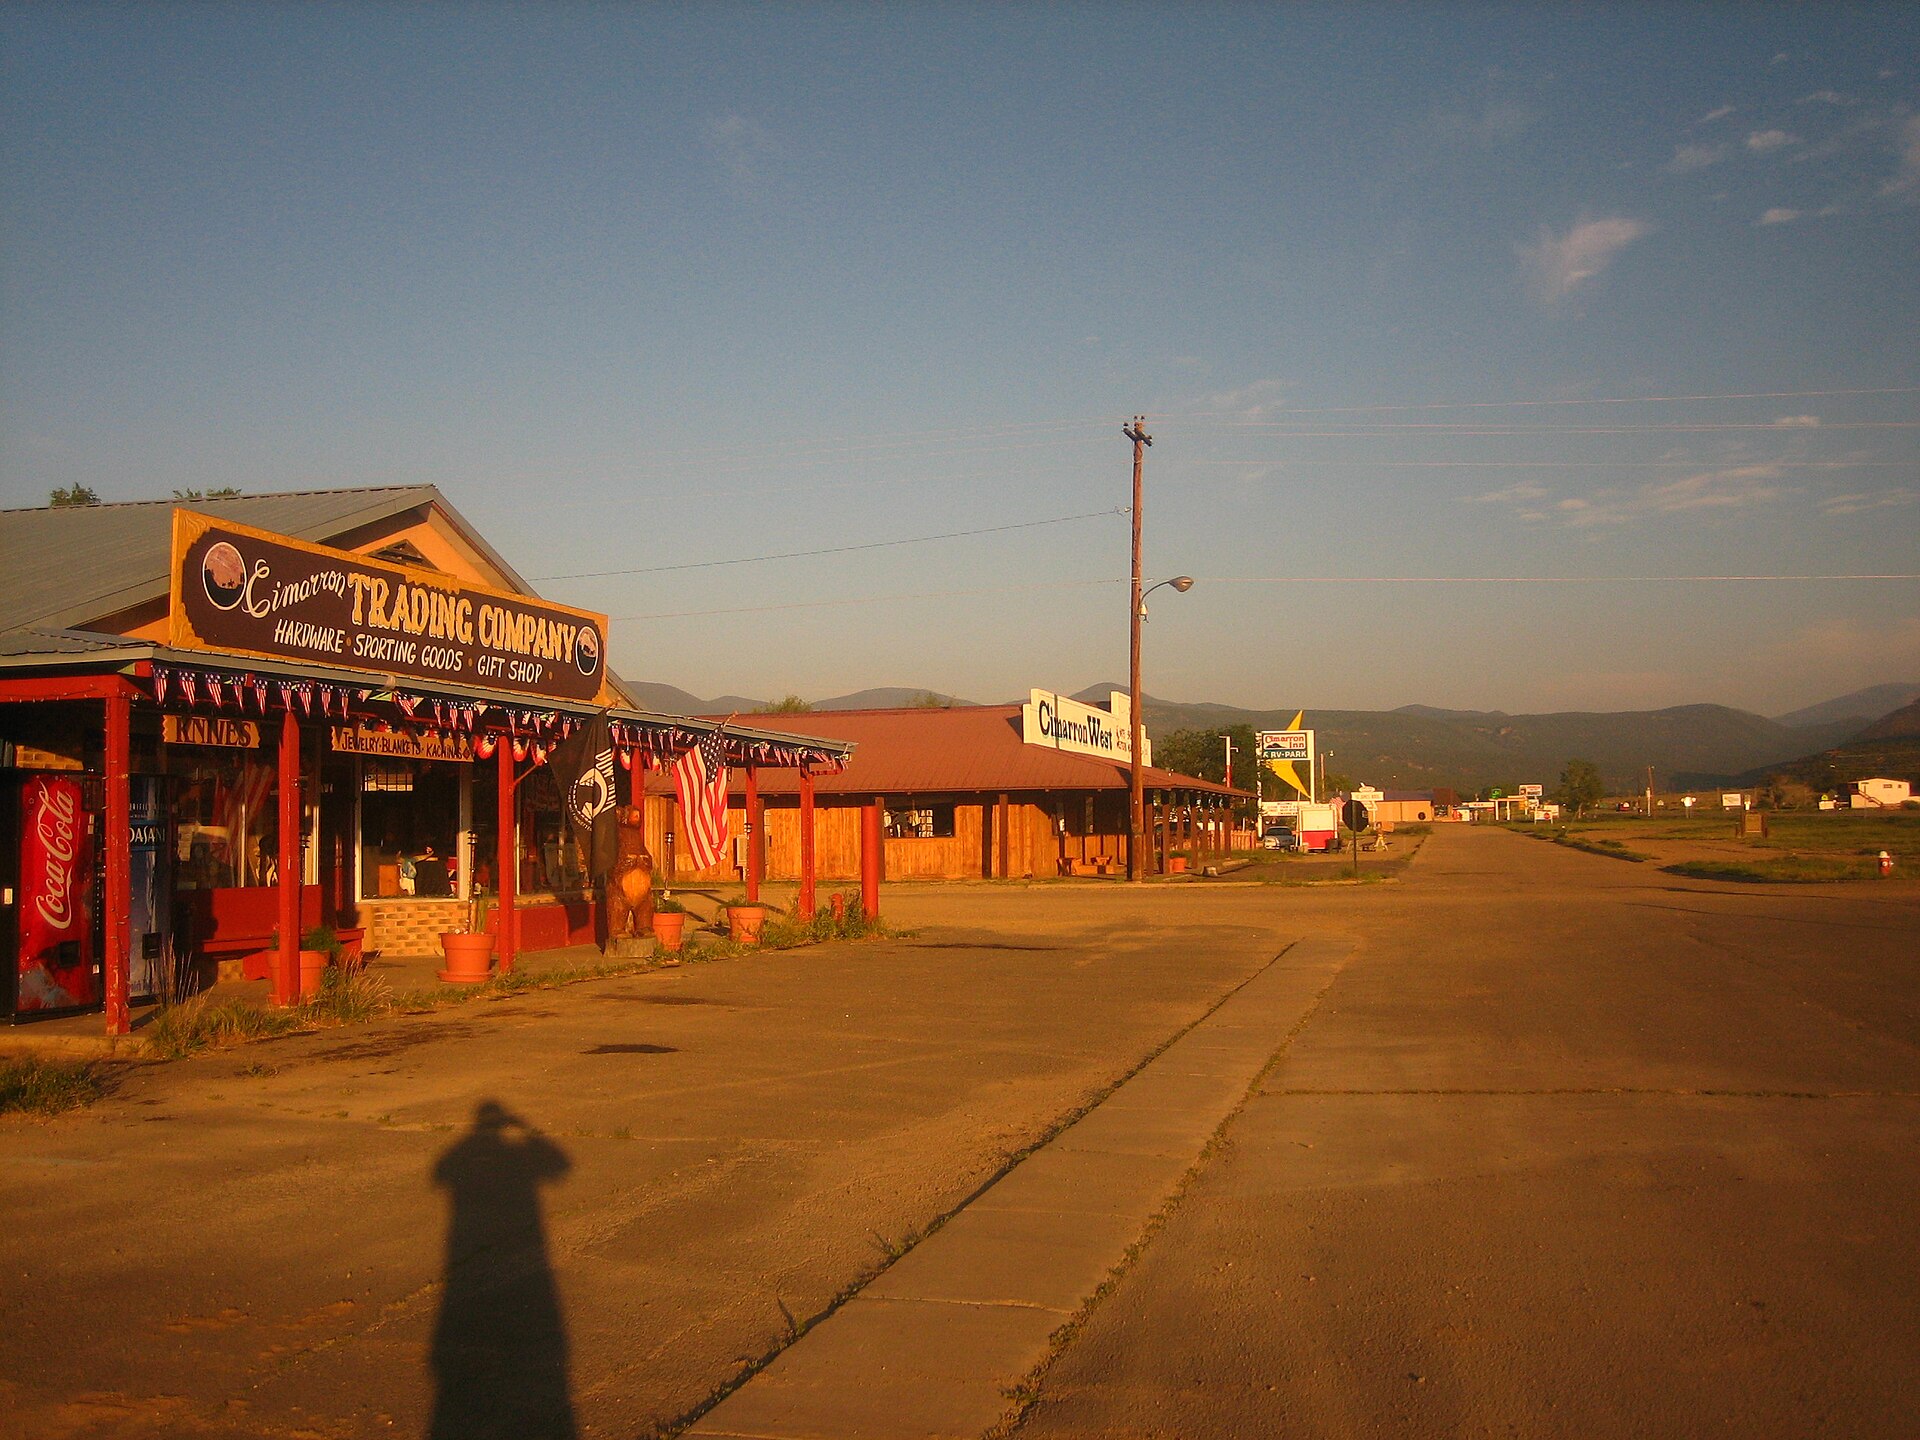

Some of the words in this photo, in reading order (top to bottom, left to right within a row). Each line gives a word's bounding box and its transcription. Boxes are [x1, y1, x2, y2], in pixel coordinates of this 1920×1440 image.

[242, 559, 346, 618] Cimarron
[347, 572, 474, 645] TRADING
[478, 604, 577, 663] COMPANY
[274, 618, 346, 653] HARDWARE
[353, 633, 417, 664] SPORTING
[421, 645, 464, 671] GOODS
[477, 655, 506, 676] GIFT
[508, 660, 543, 684] SHOP
[176, 716, 252, 747] KNIVES
[1039, 700, 1088, 744] Cimarron
[1087, 714, 1113, 750] West
[1265, 735, 1305, 744] Cimarron
[35, 780, 74, 929] Coca-Cola
